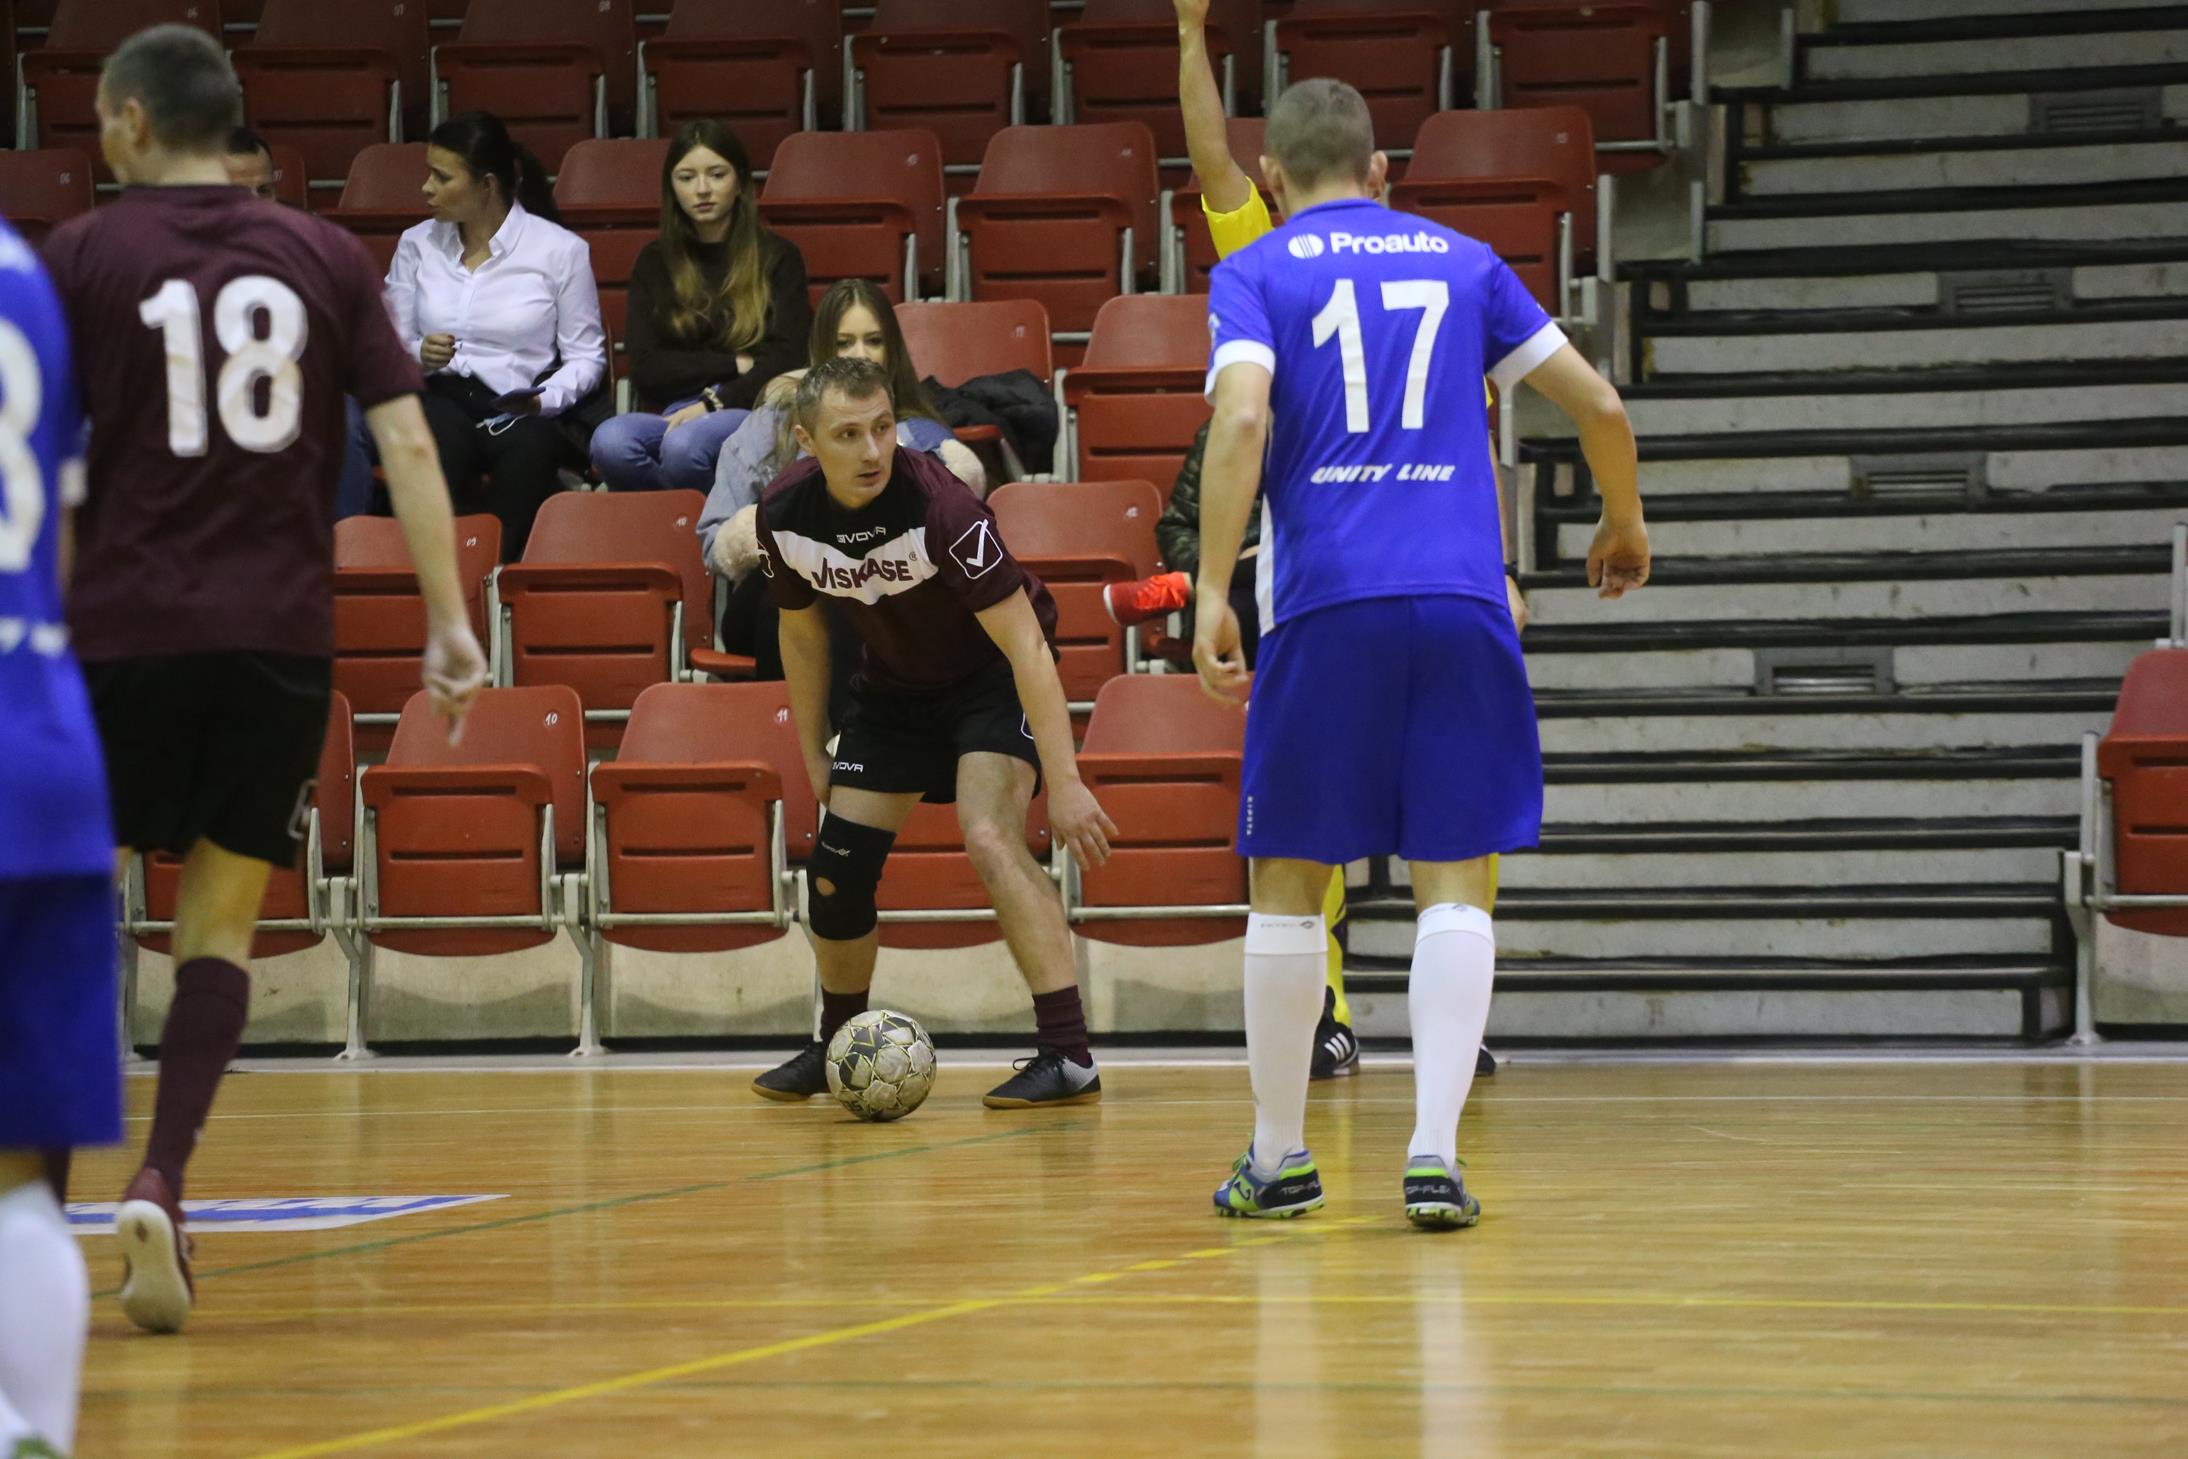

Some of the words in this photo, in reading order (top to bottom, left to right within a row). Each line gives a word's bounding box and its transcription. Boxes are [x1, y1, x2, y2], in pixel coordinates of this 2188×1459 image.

[1330, 230, 1449, 254] Proauto
[138, 274, 309, 457] 18
[1311, 278, 1450, 433] 17
[1310, 463, 1393, 484] UNITY
[1396, 463, 1456, 482] LINE
[811, 557, 914, 589] VISKASE
[545, 712, 558, 726] 10
[776, 708, 789, 722] 11
